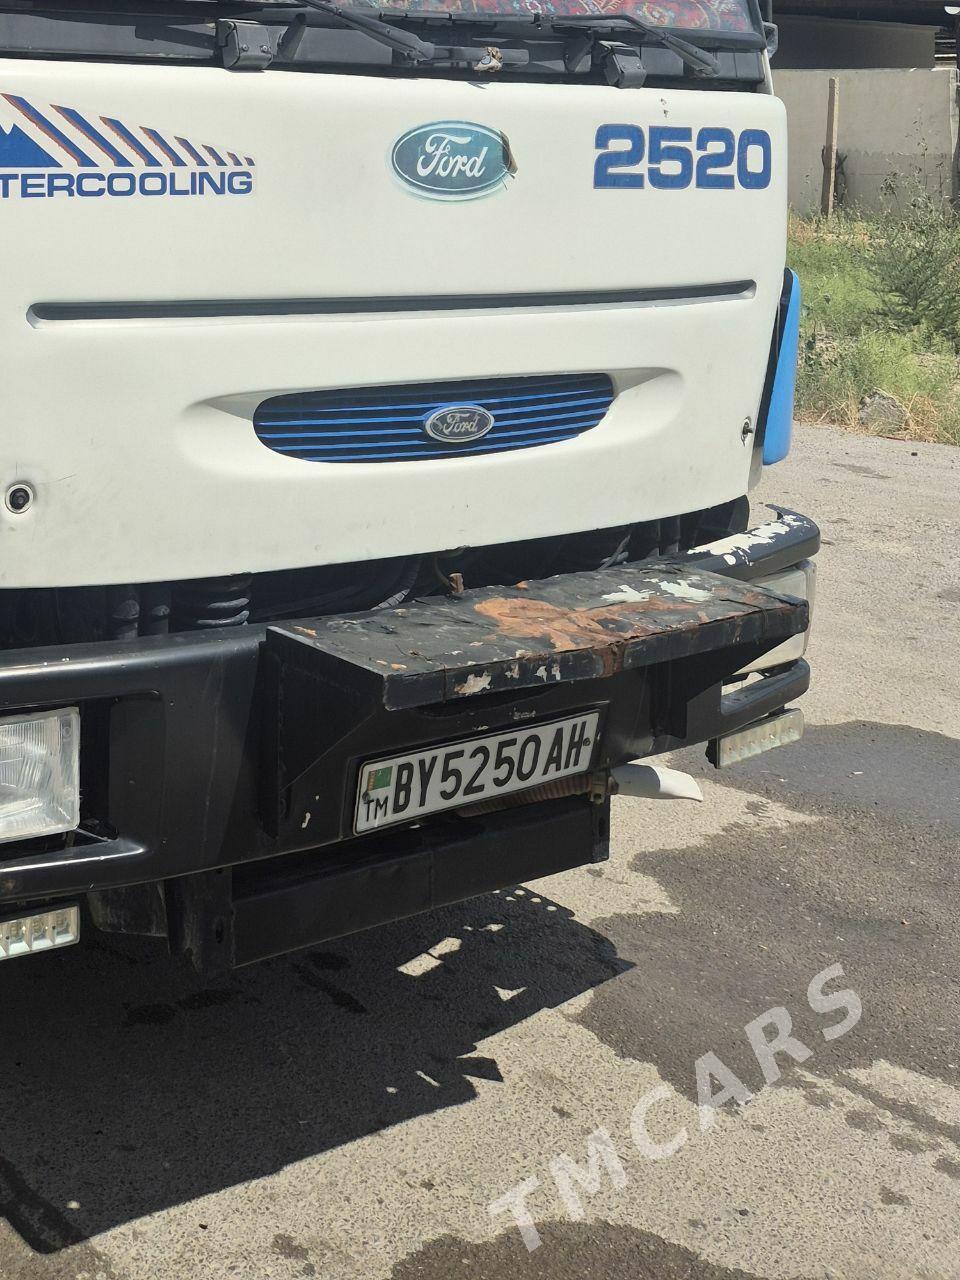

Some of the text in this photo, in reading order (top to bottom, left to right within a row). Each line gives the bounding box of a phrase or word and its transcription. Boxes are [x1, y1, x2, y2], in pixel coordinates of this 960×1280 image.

[416, 133, 489, 179] Ford
[593, 123, 772, 190] 2520
[442, 412, 481, 434] Ford
[363, 794, 389, 823] TM
